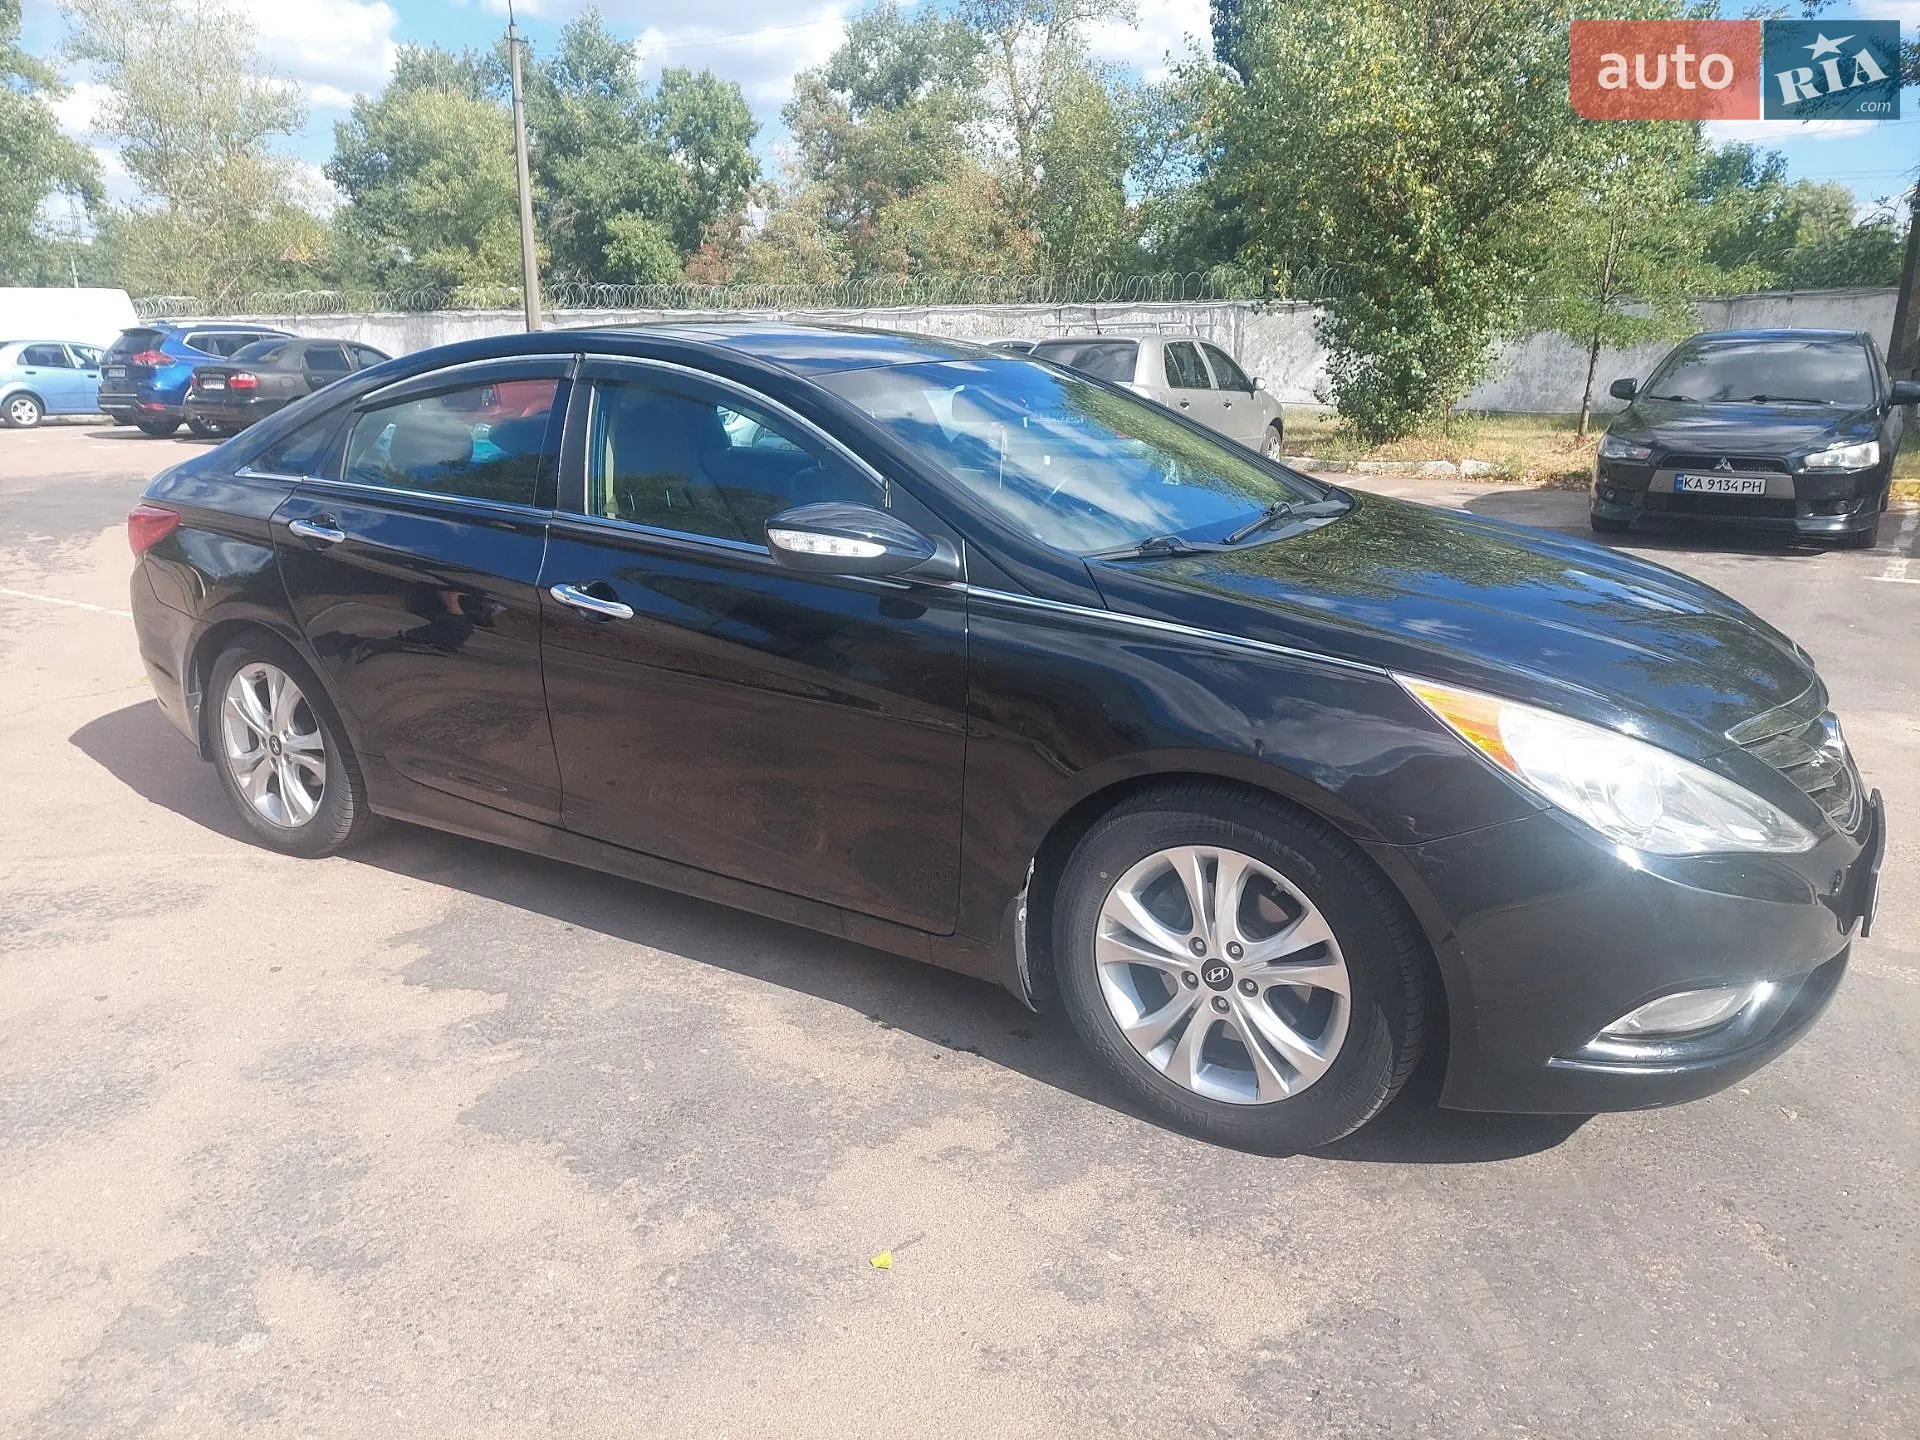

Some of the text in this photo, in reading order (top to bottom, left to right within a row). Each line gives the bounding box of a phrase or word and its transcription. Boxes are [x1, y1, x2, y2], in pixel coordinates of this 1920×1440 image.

[1683, 477, 1763, 493] KA 9134 PH
